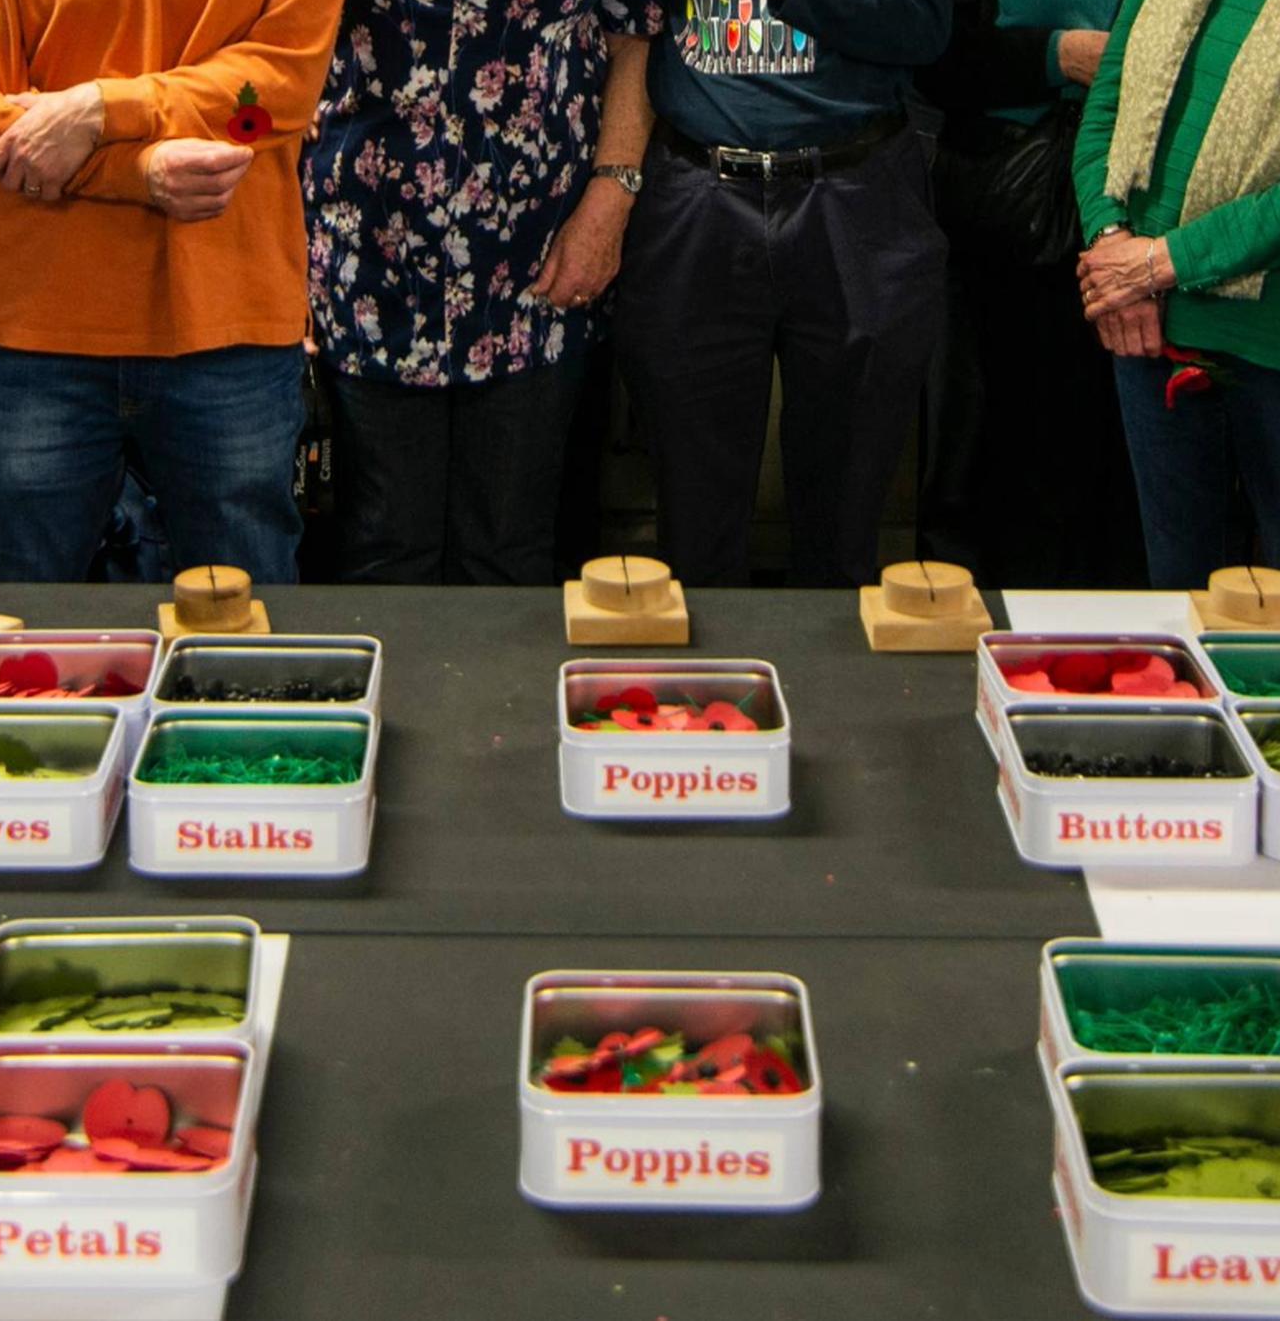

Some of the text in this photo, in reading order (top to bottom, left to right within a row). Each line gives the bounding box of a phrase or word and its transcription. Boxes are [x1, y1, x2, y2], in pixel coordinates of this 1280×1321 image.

[602, 764, 758, 799] Poppies
[177, 820, 314, 851] Stalks
[1058, 812, 1224, 842] Buttons
[567, 1138, 771, 1184] Poppies
